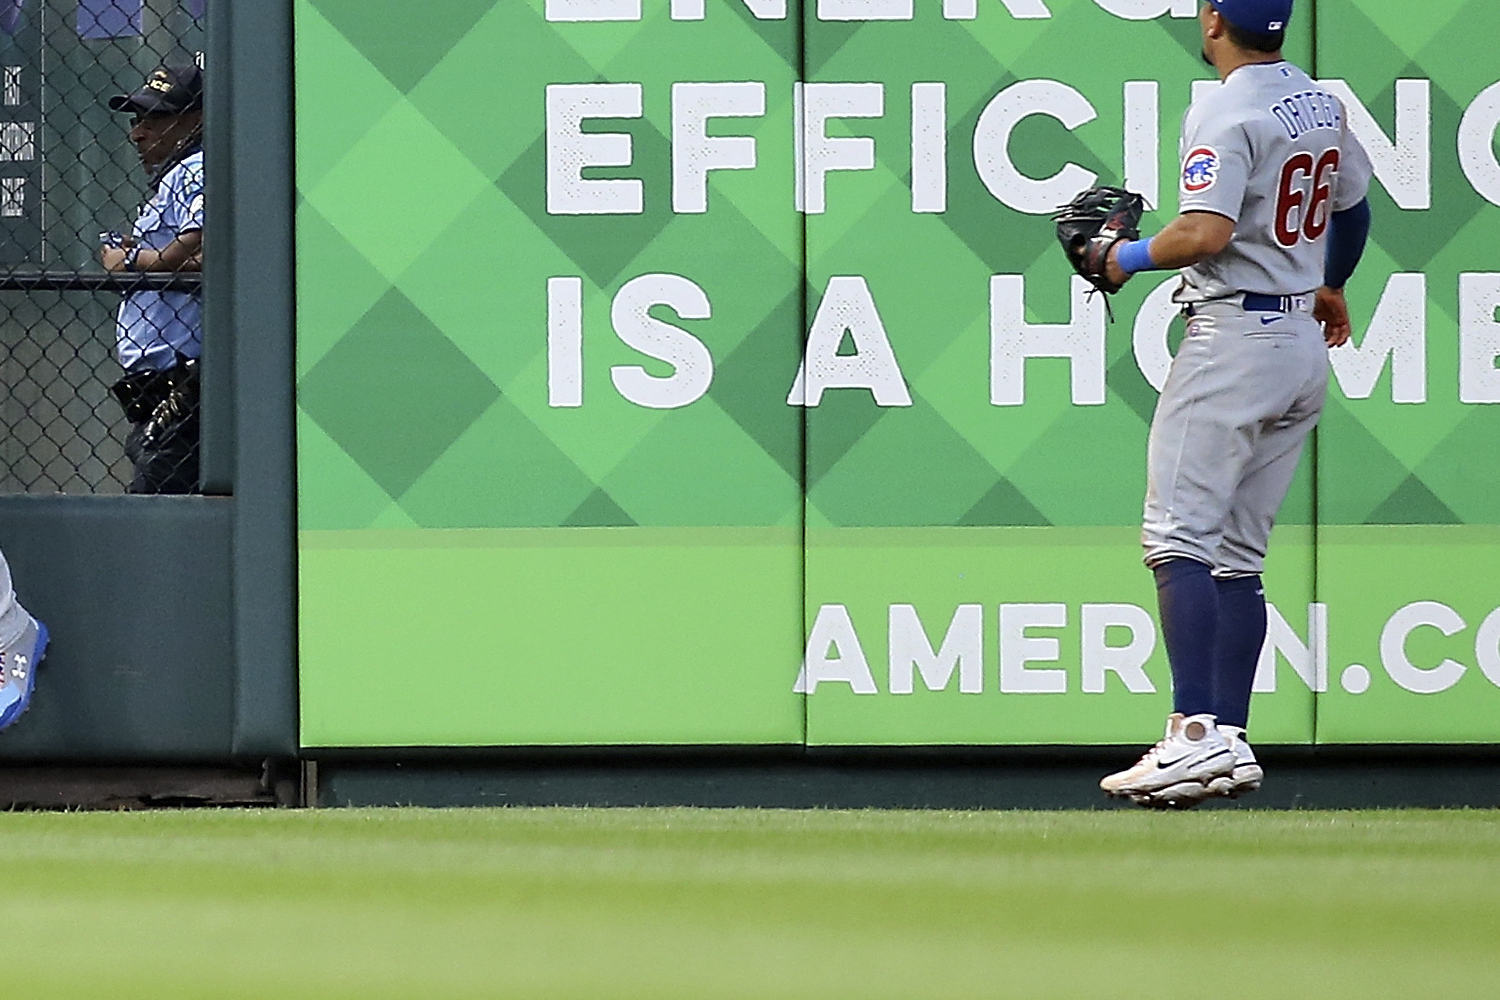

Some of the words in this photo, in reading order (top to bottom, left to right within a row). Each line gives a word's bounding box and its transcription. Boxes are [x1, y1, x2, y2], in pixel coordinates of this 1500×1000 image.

[1272, 147, 1342, 249] 66
[546, 273, 714, 408] IS
[786, 274, 913, 407] A
